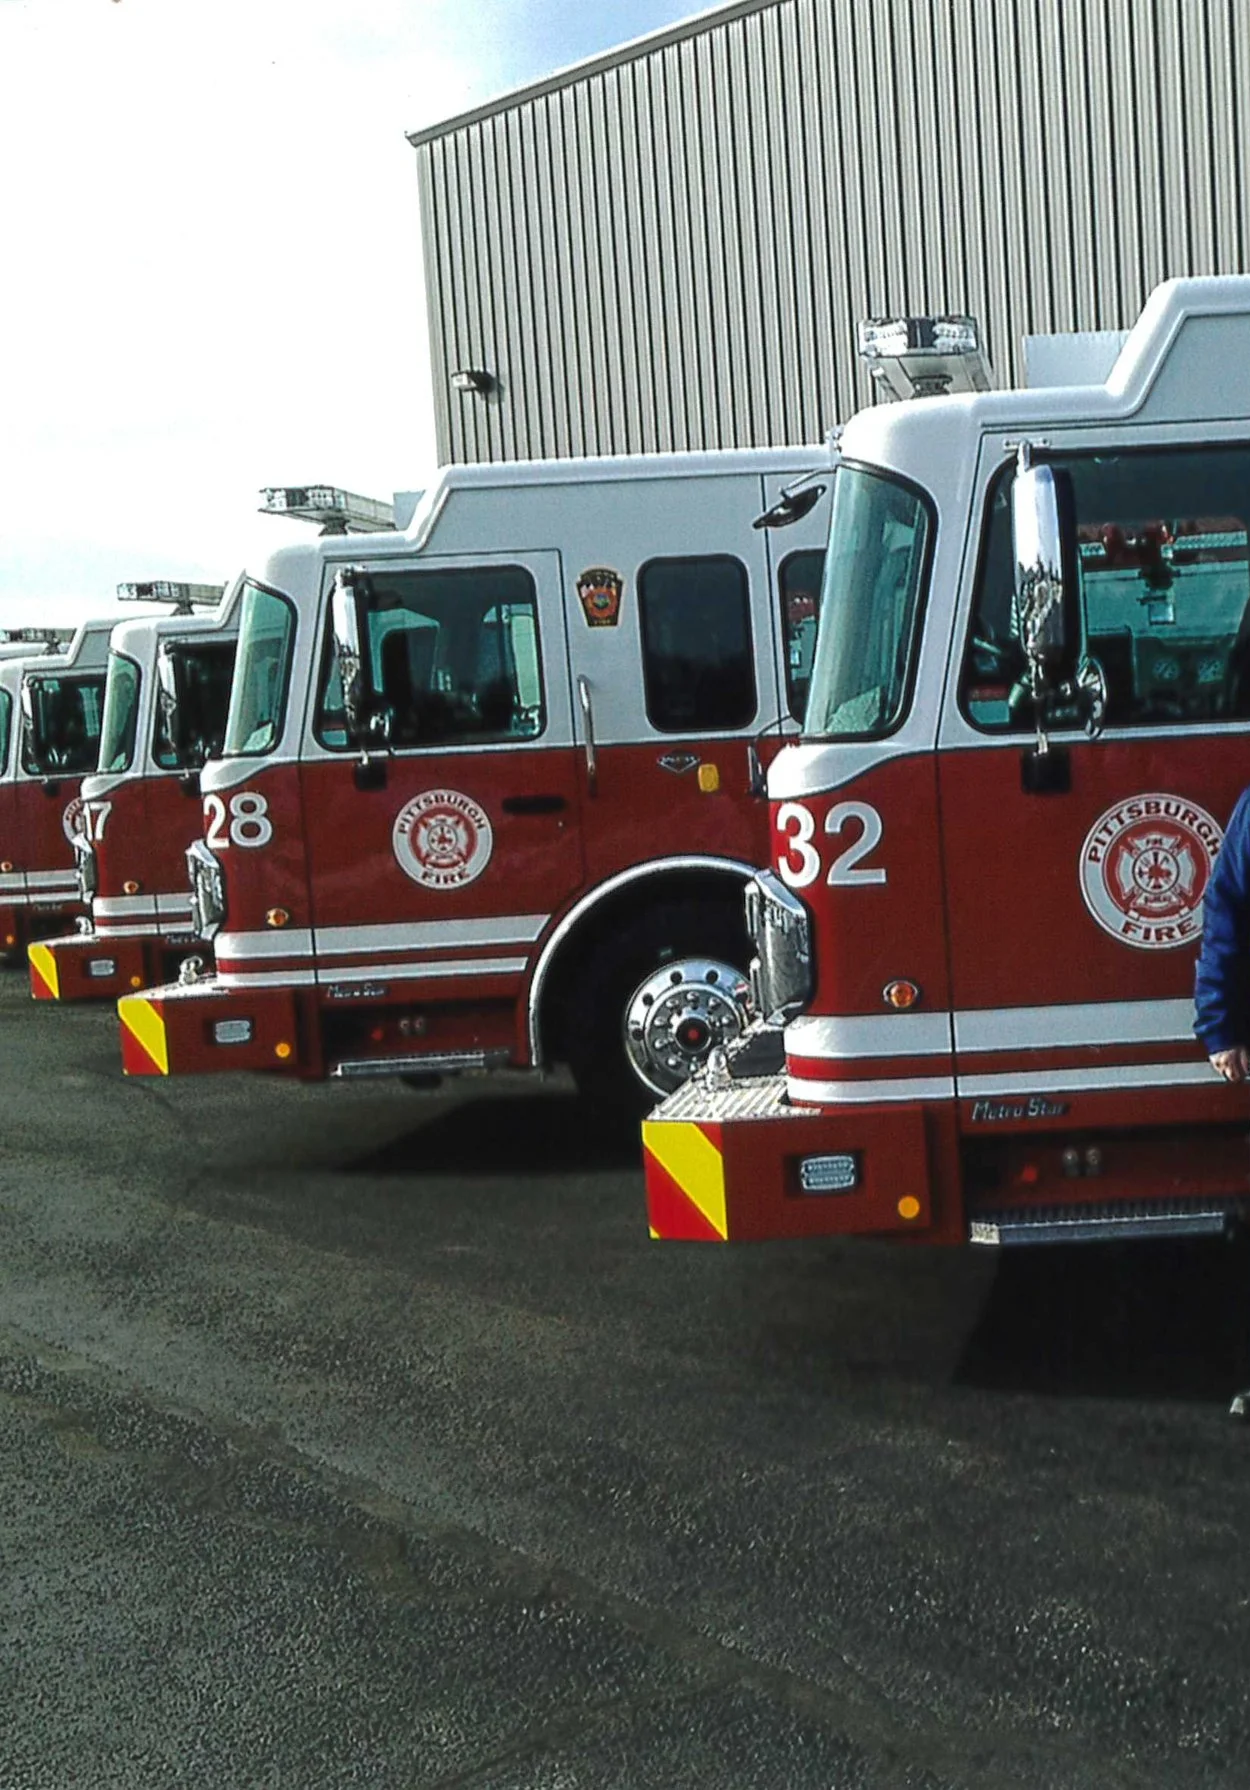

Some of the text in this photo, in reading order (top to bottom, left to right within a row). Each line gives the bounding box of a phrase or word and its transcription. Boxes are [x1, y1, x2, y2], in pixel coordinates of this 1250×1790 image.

[203, 792, 273, 848] 28
[398, 794, 486, 834] PITTSBURGH
[1088, 801, 1220, 863] PITTSBURGH
[776, 801, 887, 887] 32
[421, 871, 470, 884] FIRE
[1121, 916, 1198, 941] FIRE
